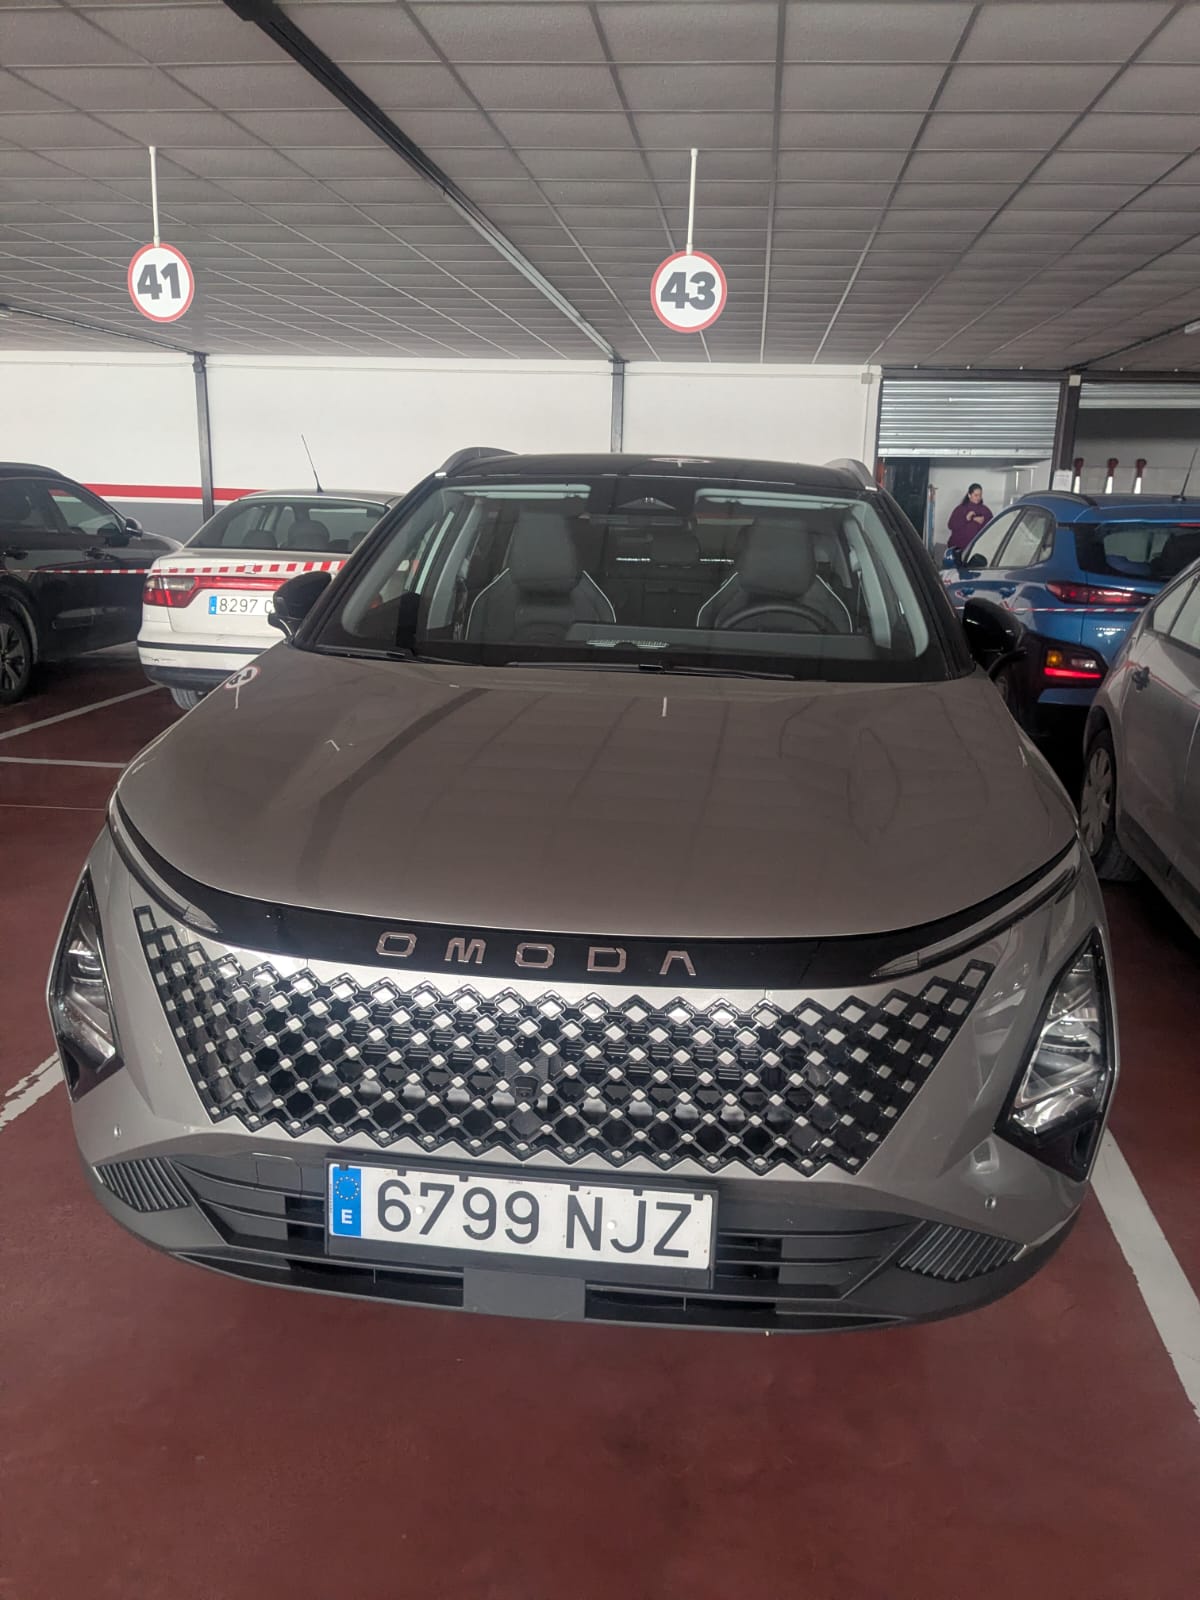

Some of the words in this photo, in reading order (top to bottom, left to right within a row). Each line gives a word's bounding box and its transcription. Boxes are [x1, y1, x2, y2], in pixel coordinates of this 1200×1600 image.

[137, 263, 181, 300] 41
[660, 271, 716, 310] 43
[220, 598, 258, 613] 8297
[376, 931, 696, 976] OMODA
[341, 1209, 353, 1225] E
[377, 1179, 540, 1244] 6799
[566, 1194, 692, 1258] NJZ
